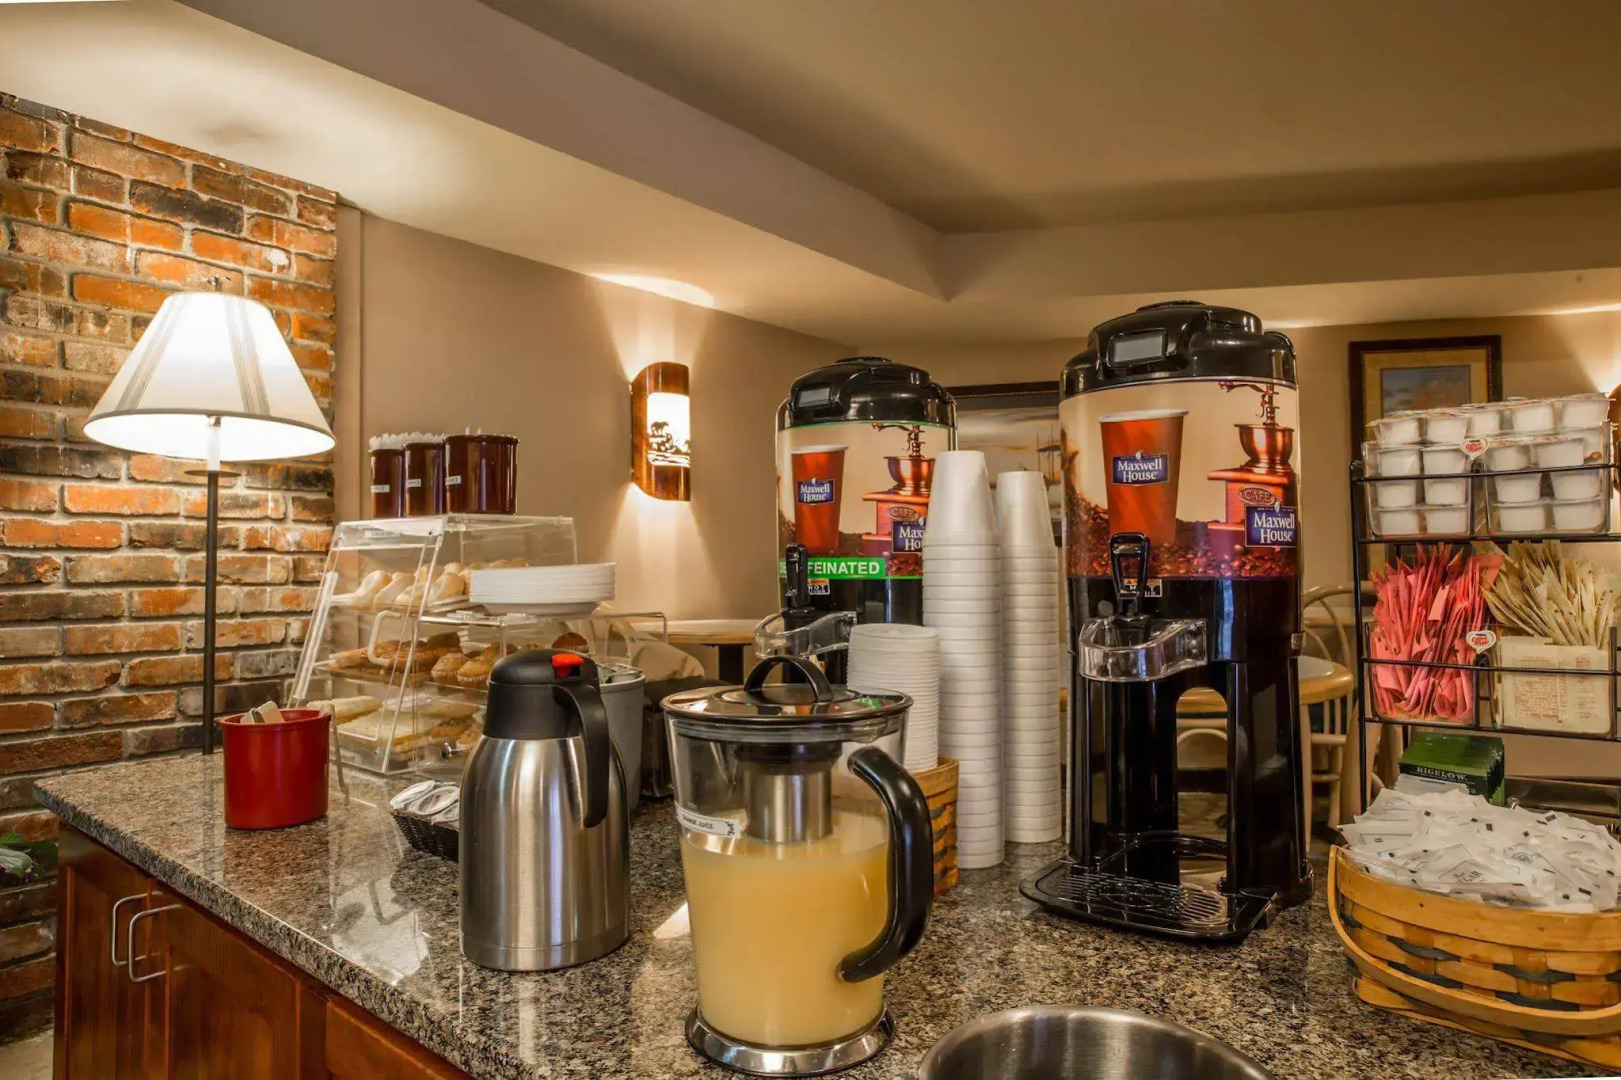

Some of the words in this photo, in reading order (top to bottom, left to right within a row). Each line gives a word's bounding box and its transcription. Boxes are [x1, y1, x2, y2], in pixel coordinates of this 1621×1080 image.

[1117, 458, 1163, 471] Maxwell
[1122, 470, 1159, 483] House
[800, 483, 830, 493] Maxwell
[803, 493, 827, 502] House
[1253, 512, 1295, 529] Maxwell
[1260, 528, 1293, 544] House
[1416, 767, 1466, 780] BIGELOW
